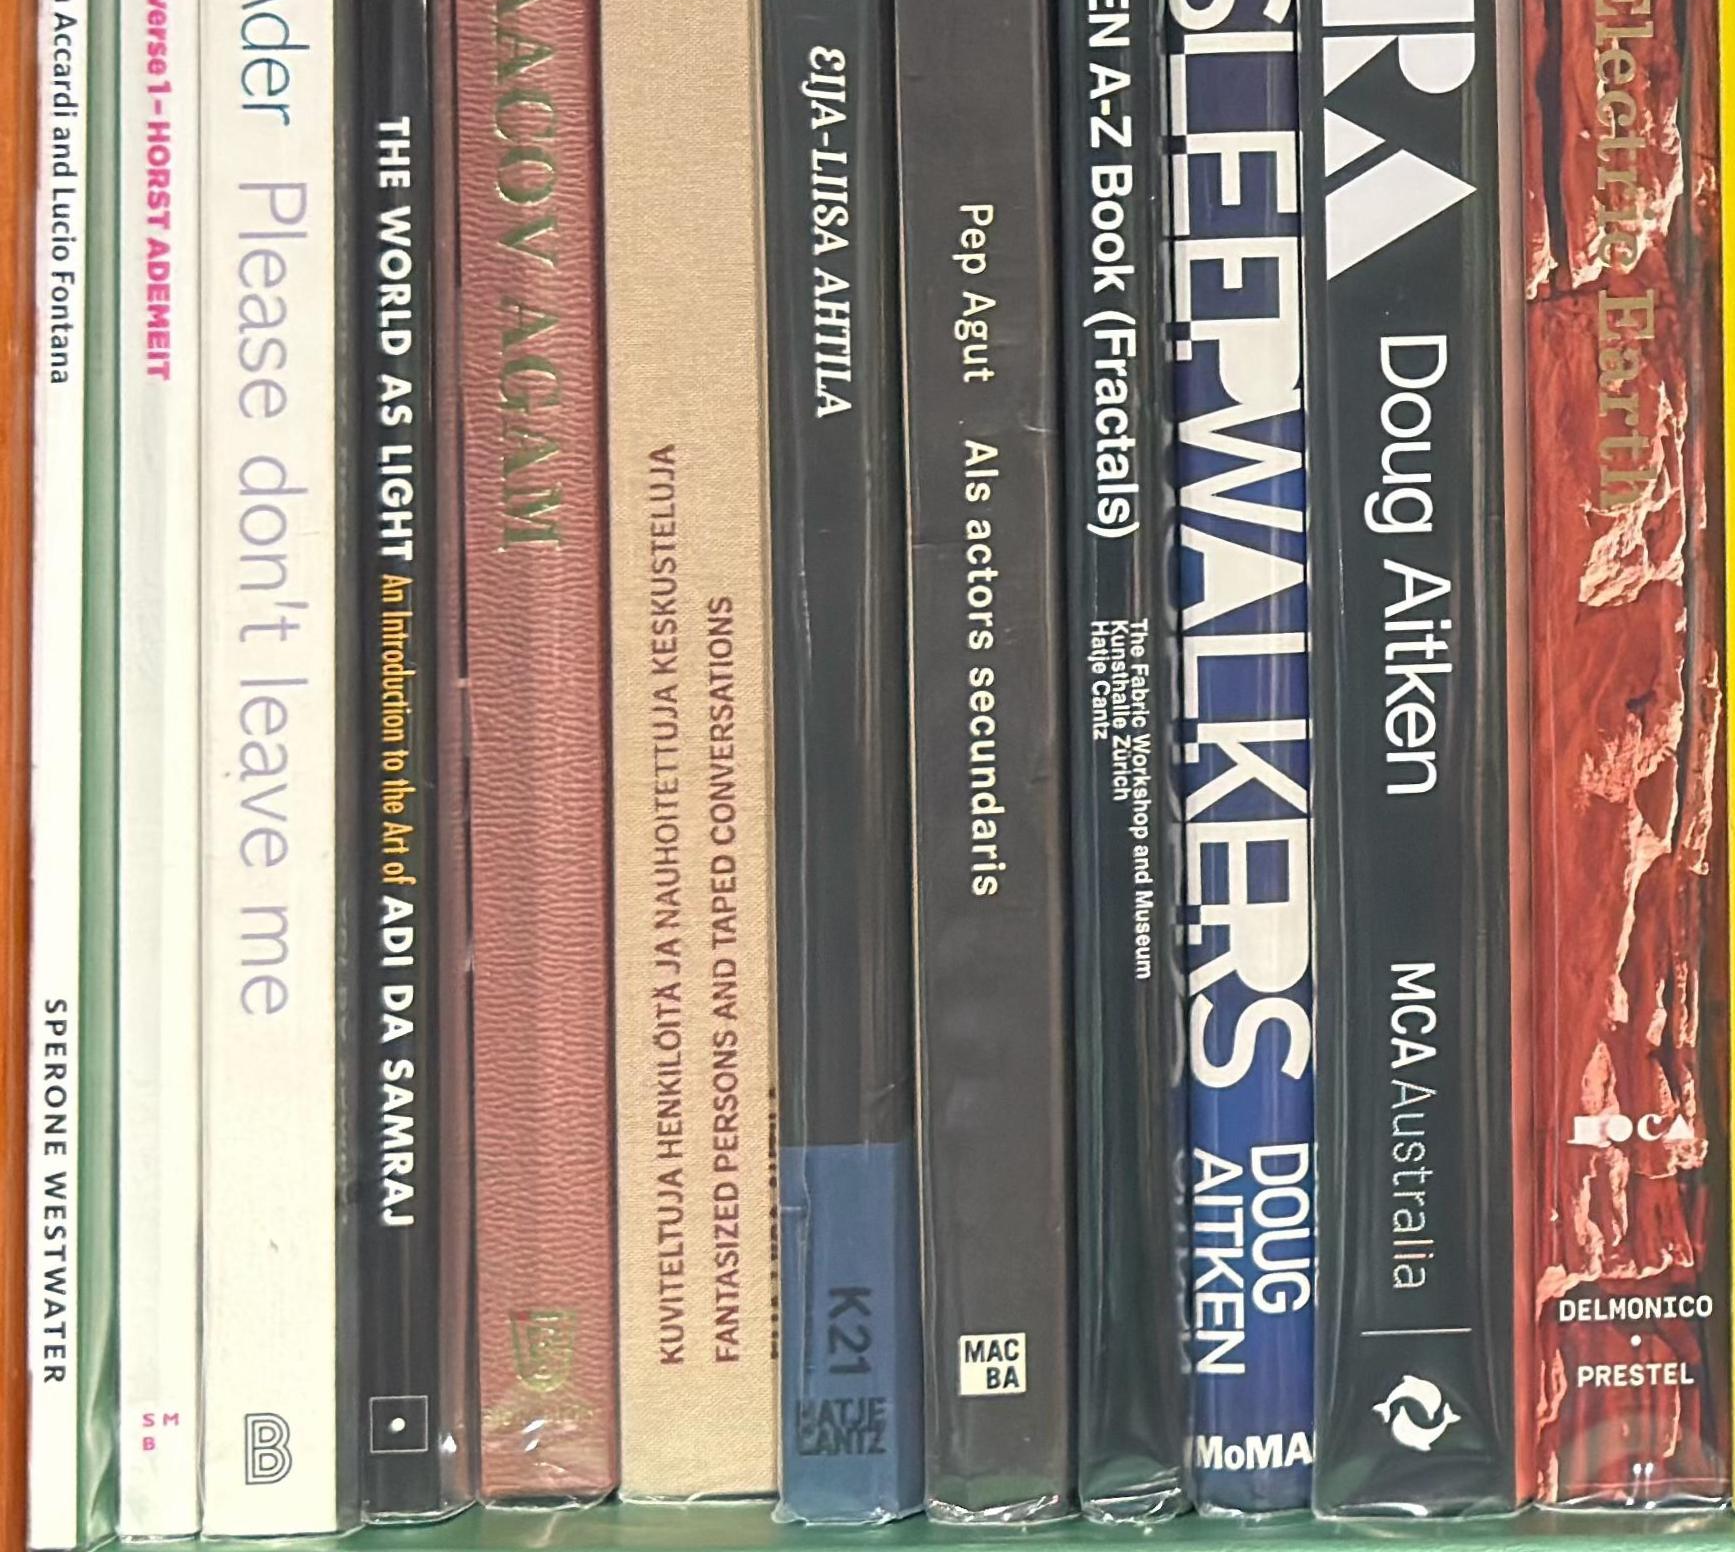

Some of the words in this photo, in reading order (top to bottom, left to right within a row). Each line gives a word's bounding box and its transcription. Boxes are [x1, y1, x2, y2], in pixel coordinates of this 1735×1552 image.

[53, 11, 79, 117] Accardi
[1089, 62, 1132, 148] A-Z
[52, 126, 78, 177] and
[146, 121, 172, 231] HORST
[378, 116, 411, 188] THE
[803, 45, 849, 256] EIJA-LIISA
[51, 187, 77, 262] Lucio
[379, 205, 412, 356] WORLD
[951, 204, 994, 275] Pep
[1091, 164, 1135, 293] Book
[50, 271, 76, 384] Fontana
[146, 237, 172, 382] ADEMEIT
[237, 182, 308, 419] Please
[813, 266, 852, 418] AHTILA
[953, 291, 997, 383] Agut
[380, 374, 413, 426] AS
[498, 303, 562, 553] AGAM
[1082, 310, 1138, 538] (Fractals)
[1363, 334, 1448, 534] Doug
[1596, 288, 1658, 510] Earth
[380, 444, 414, 561] LIGHT
[964, 439, 999, 502] Als
[238, 455, 310, 643] don't
[647, 443, 678, 676] KESKUSTELUJA
[965, 519, 999, 650] actors
[1130, 617, 1149, 658] The
[1130, 663, 1150, 728] Fabric
[1383, 558, 1453, 795] Aitken
[238, 677, 309, 868] leave
[651, 683, 681, 930] NAUHOITETTUJA
[968, 667, 1007, 896] secundaris
[1131, 733, 1152, 840] Workshop
[1133, 845, 1154, 884] and
[239, 905, 289, 1015] me
[381, 895, 414, 967] ADI
[653, 937, 682, 975] JA
[1135, 890, 1154, 979] Museum
[44, 998, 68, 1156] SPERONE
[381, 984, 414, 1043] DA
[650, 981, 684, 1160] HENKILÖITÄ
[382, 1059, 415, 1226] SAMRAJ
[43, 1171, 67, 1384] WESTWATER
[656, 1167, 685, 1365] KUVITELTUJA
[1192, 1147, 1247, 1375] AITKEN
[1251, 1142, 1310, 1315] DOUG
[1195, 1430, 1311, 1470] MoMA
